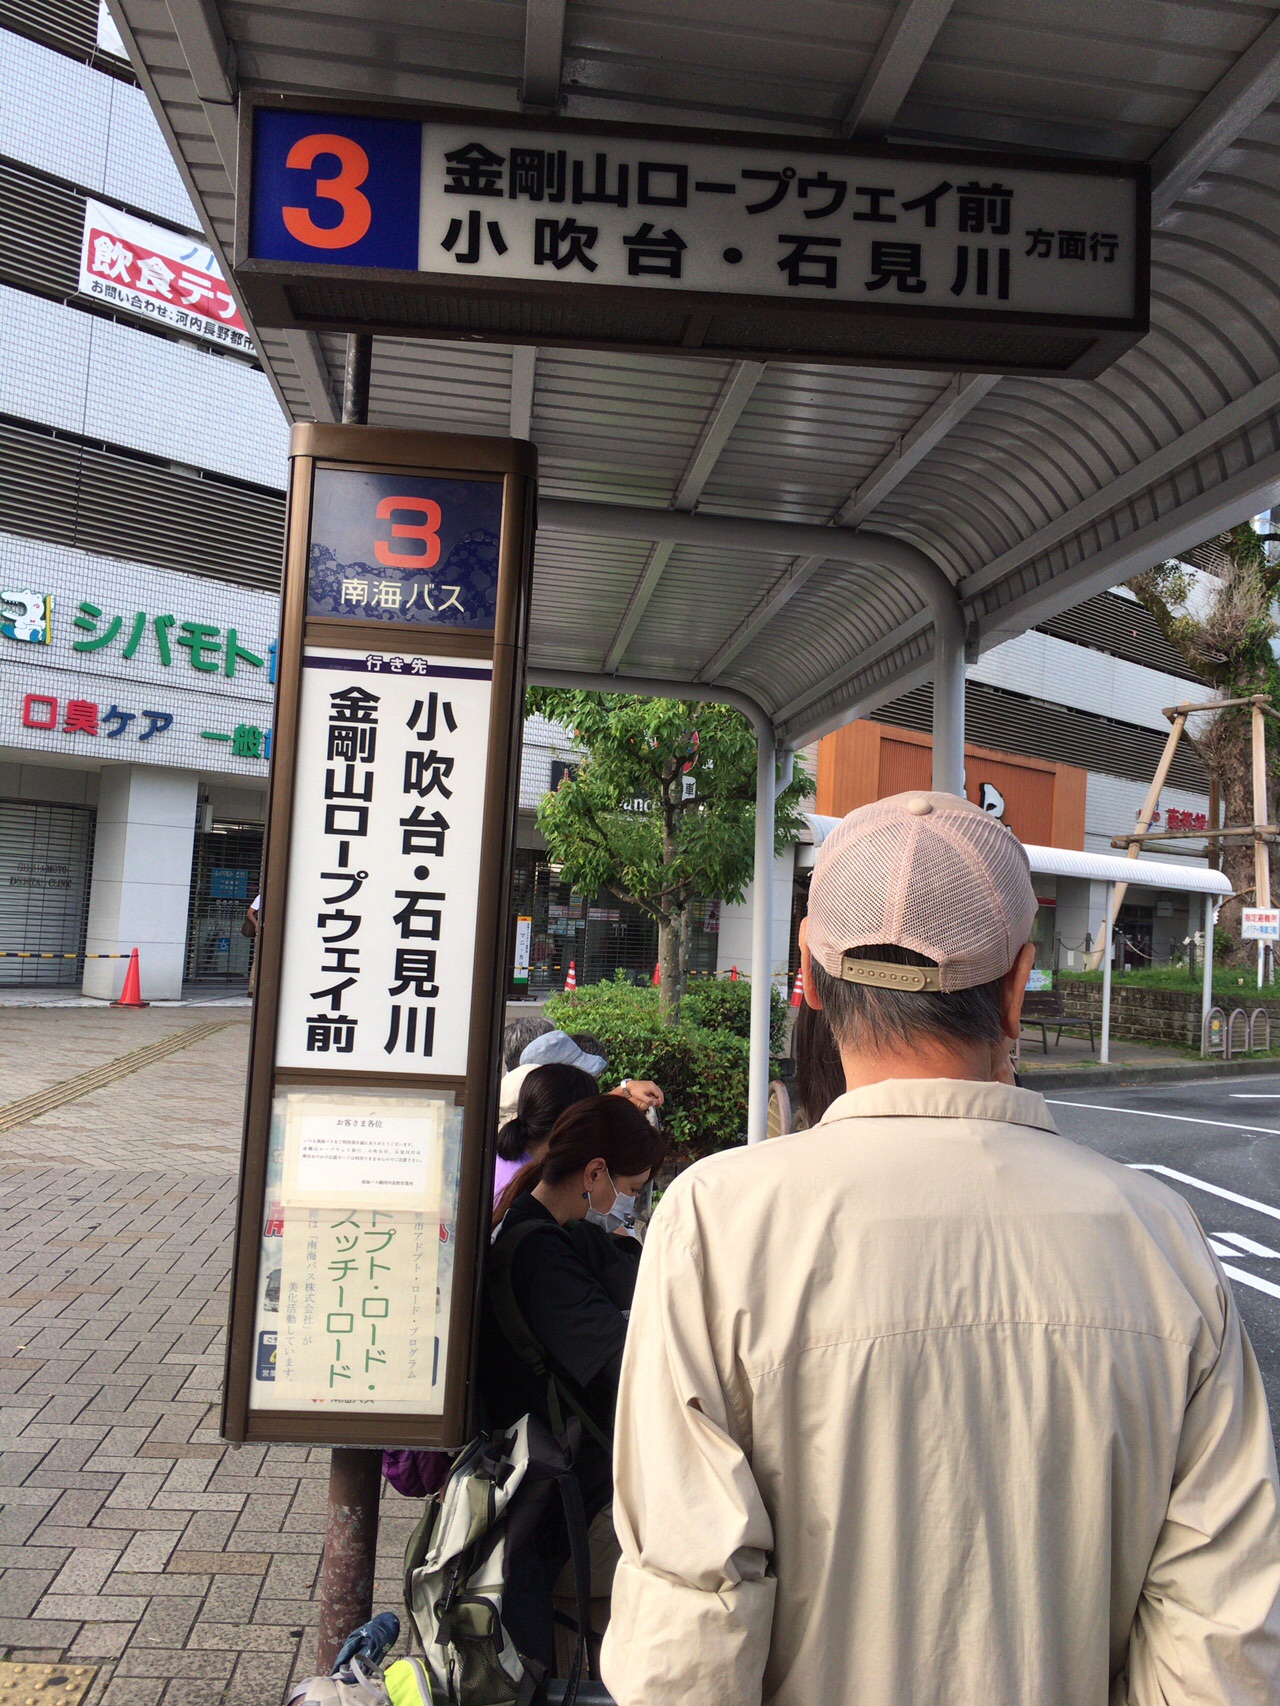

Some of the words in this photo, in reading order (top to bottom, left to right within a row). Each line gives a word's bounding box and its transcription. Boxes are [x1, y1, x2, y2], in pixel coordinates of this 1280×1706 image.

[282, 133, 372, 249] 3
[440, 209, 1011, 300] 小吹台・石見川
[1025, 228, 1119, 263] 方面行
[374, 496, 442, 569] 3
[341, 578, 465, 613] 南海バス
[74, 602, 278, 684] シバモト
[366, 655, 428, 674] 行き先
[23, 693, 174, 741] 口臭ケア
[201, 724, 272, 759] 一般
[384, 692, 458, 1057] 小吹台・石見川
[336, 1119, 383, 1128] お客さま各位
[283, 1282, 298, 1382] 美化活動しています。
